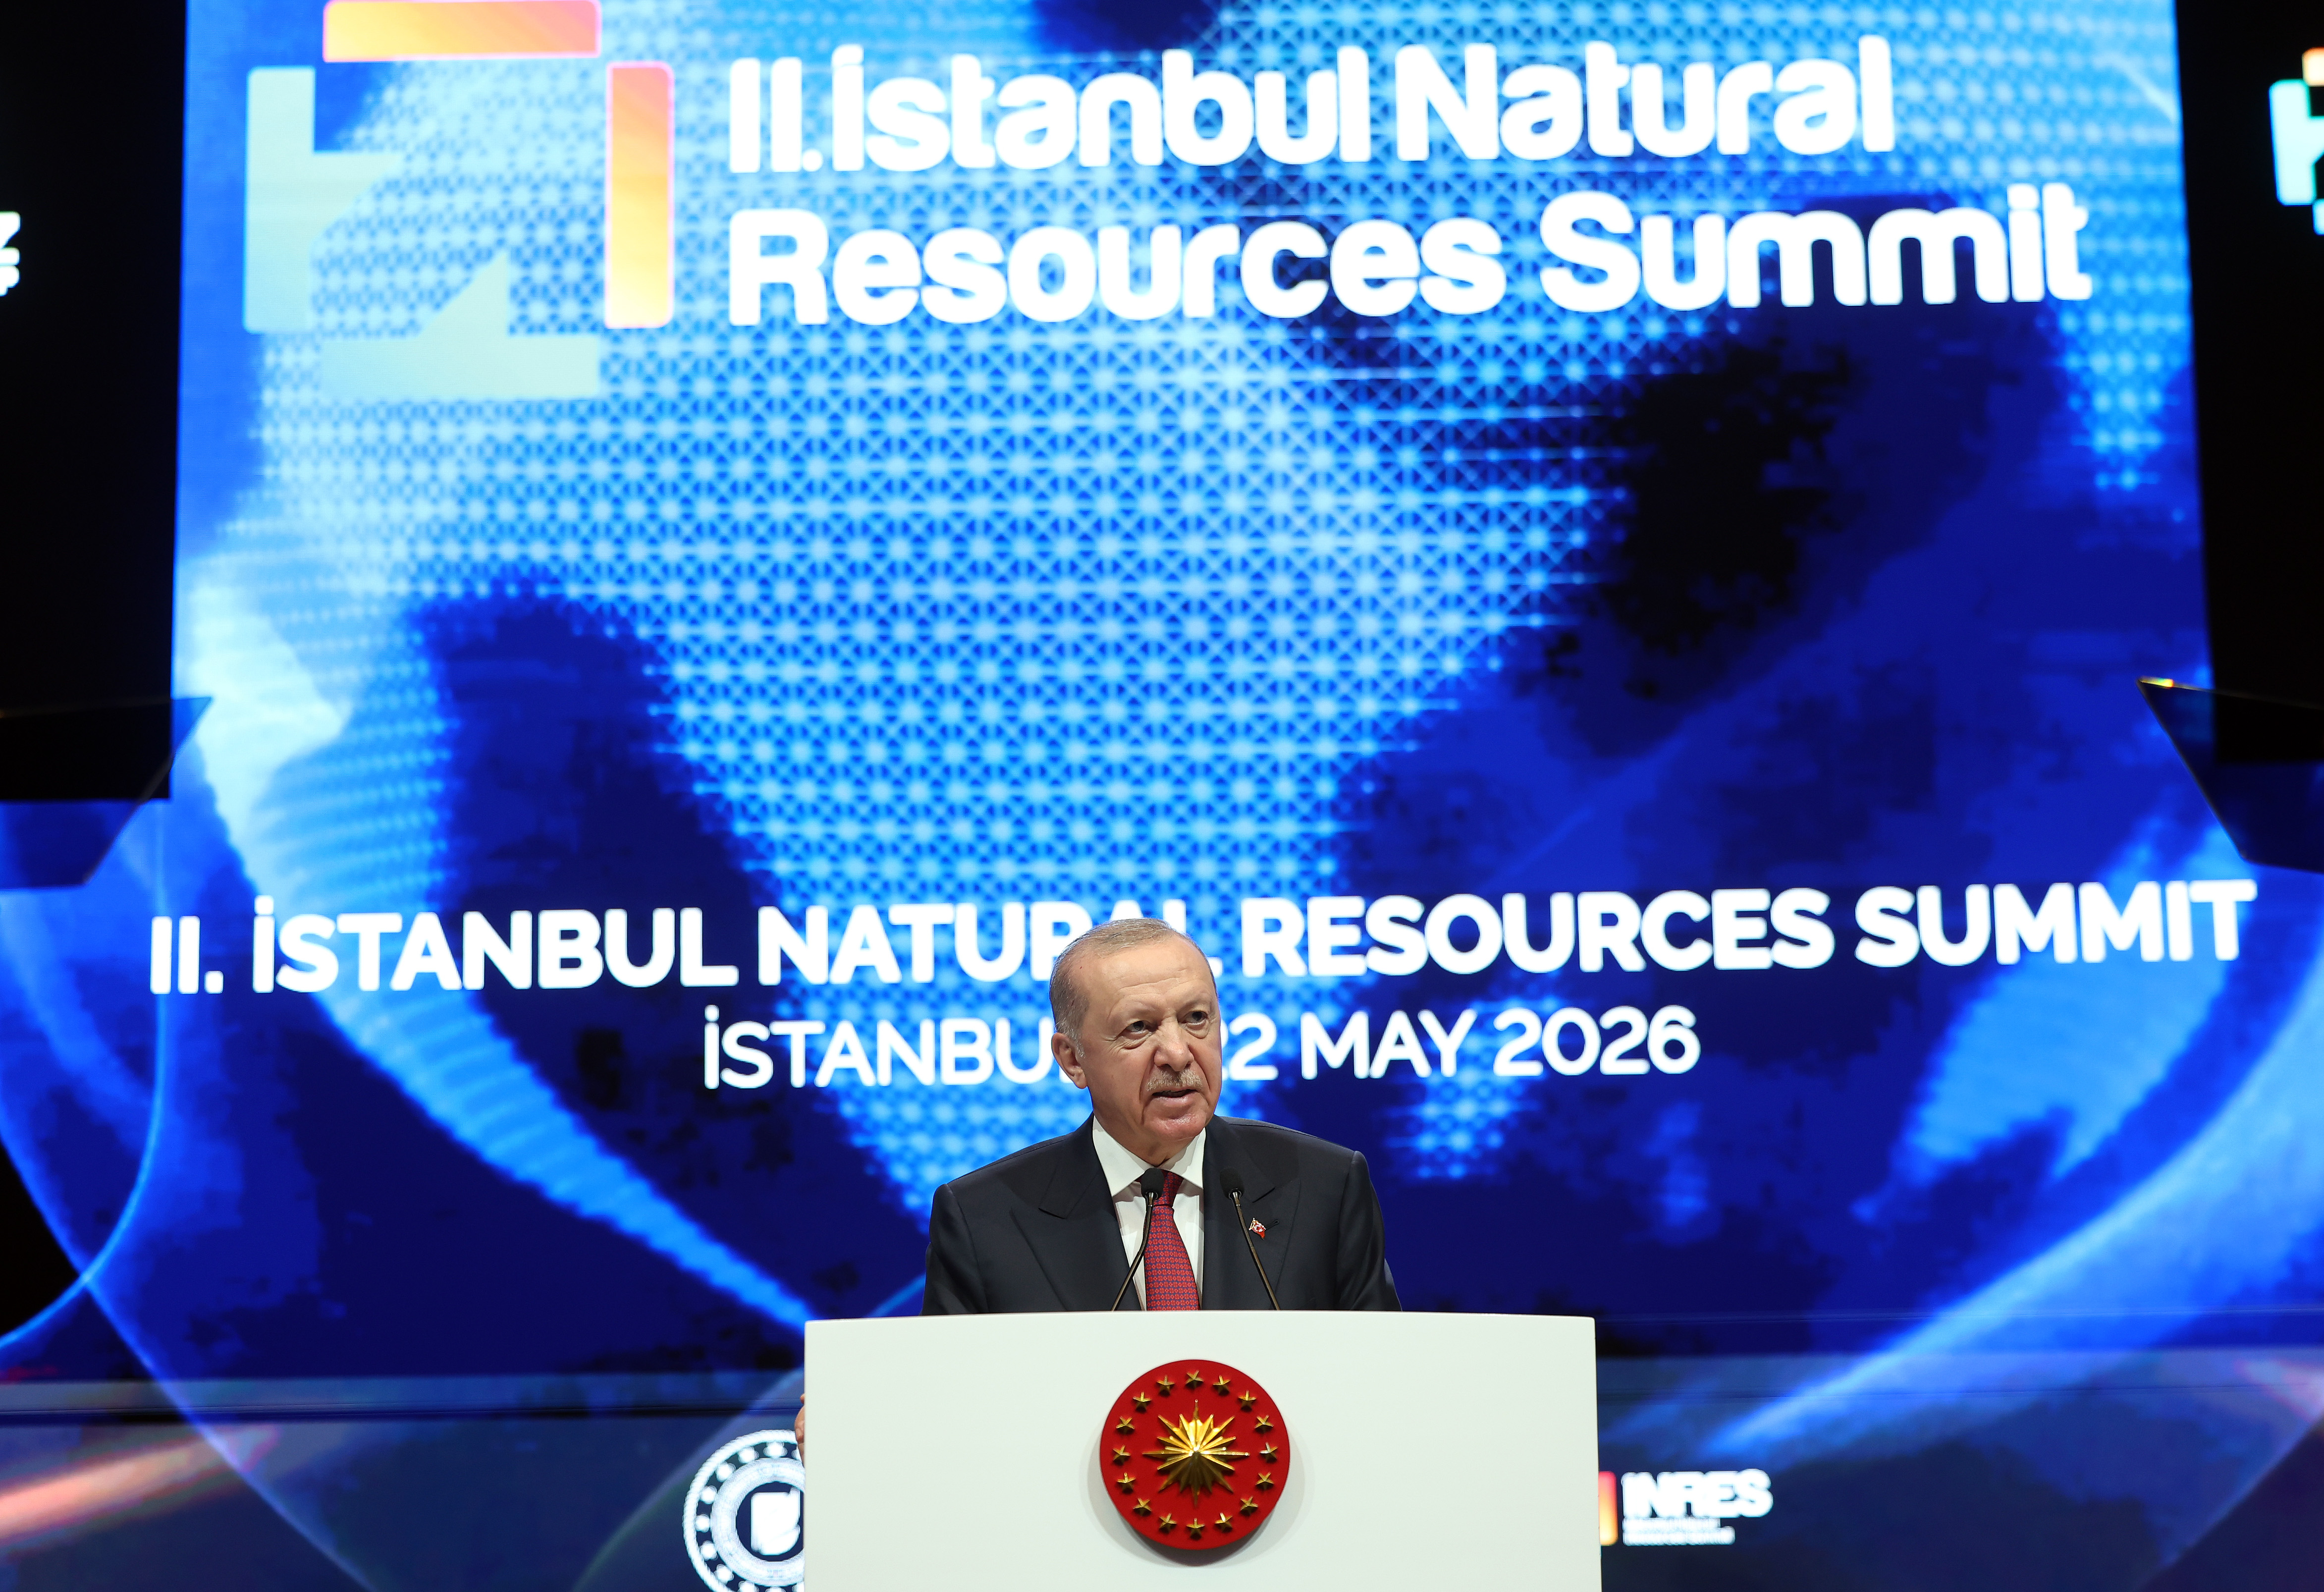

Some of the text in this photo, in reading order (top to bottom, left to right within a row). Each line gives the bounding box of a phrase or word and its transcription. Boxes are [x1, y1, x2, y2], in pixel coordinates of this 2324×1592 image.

[1394, 35, 1895, 162] Natural
[729, 182, 2092, 326] Resources Summit
[150, 879, 2257, 994] II. İSTANBUL NATUR RESOURCES SUMMIT
[704, 1004, 1074, 1089] İSTANBU
[1300, 1009, 1476, 1080] MAY
[1493, 1005, 1700, 1077] 2026
[1621, 1469, 1773, 1517] INRES
